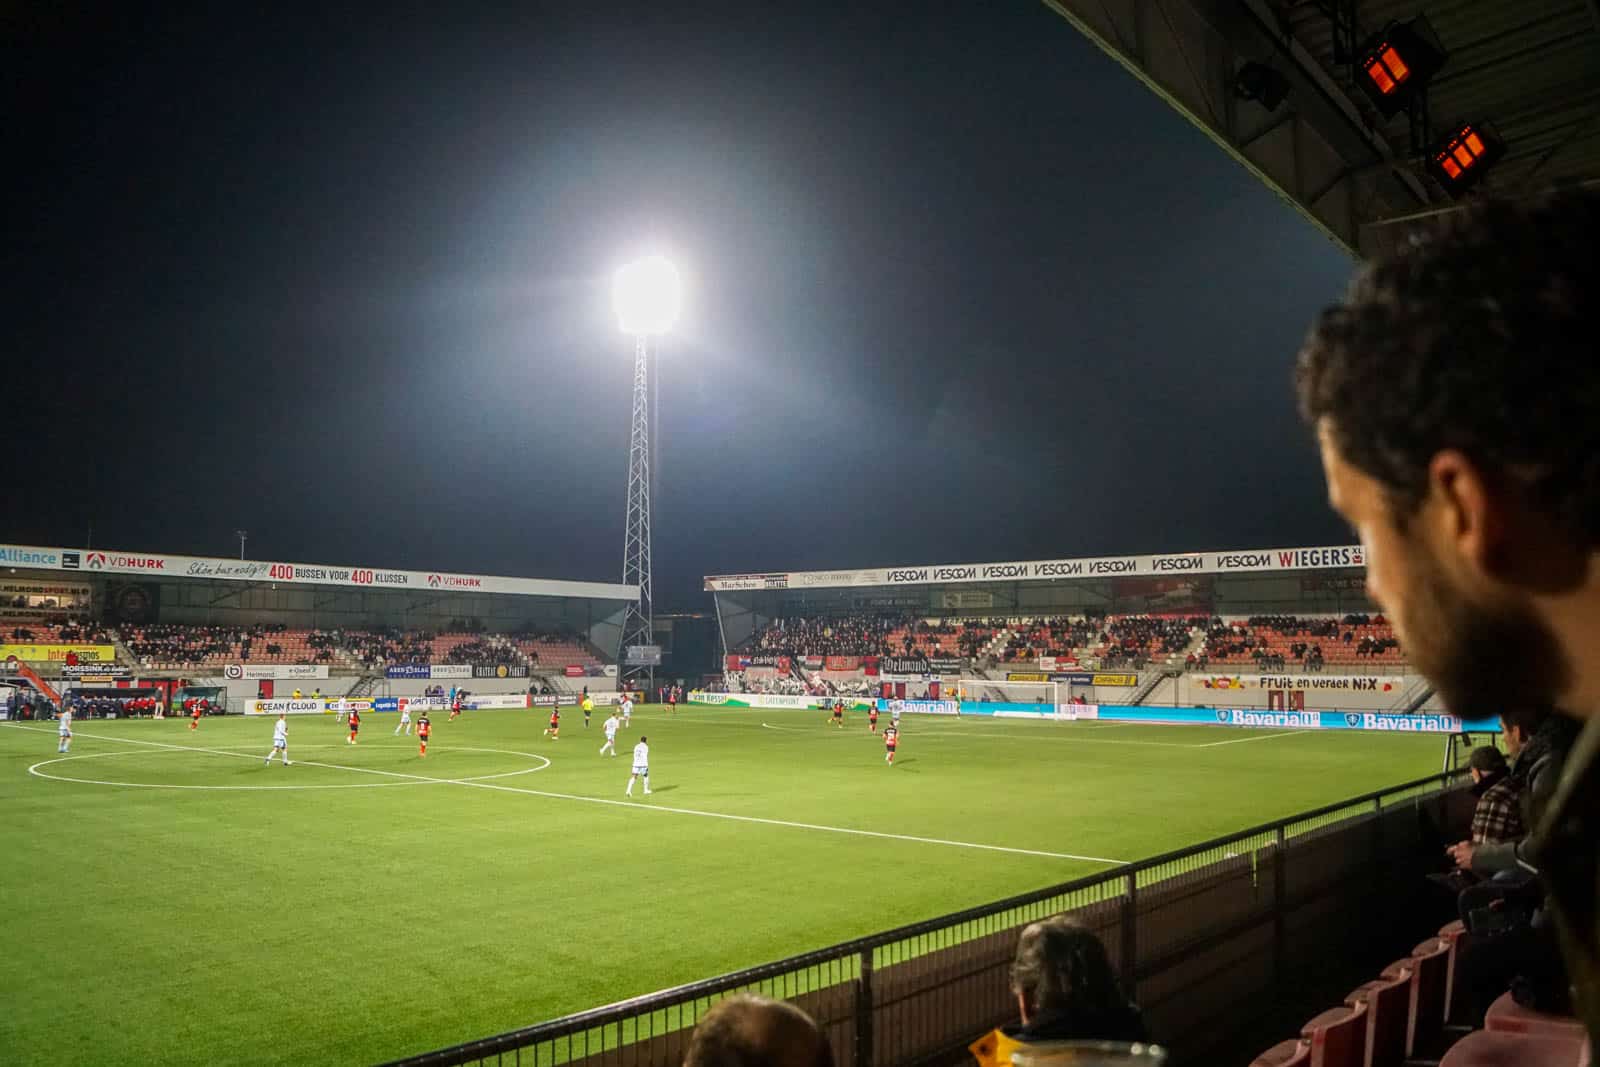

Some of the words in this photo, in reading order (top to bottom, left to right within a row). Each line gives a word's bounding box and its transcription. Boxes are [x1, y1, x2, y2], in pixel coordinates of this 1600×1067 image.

[0, 549, 57, 564] Alliance
[110, 556, 165, 569] VDHURK
[1278, 548, 1350, 567] WIEGERS
[269, 564, 293, 580] 400
[295, 568, 326, 580] BUSSEN
[329, 570, 349, 581] VOOR
[351, 570, 373, 584] 400
[375, 573, 408, 584] KLUSSEN
[887, 570, 928, 582] VESCOM
[933, 567, 976, 580] VESCOM
[982, 565, 1028, 578] VESCOM
[1034, 562, 1082, 576] VESCOM
[1089, 559, 1136, 573] VESCOM
[1152, 557, 1203, 571] VESCOM
[1217, 554, 1271, 568] VESCOM
[443, 576, 481, 587] VDHURK
[1259, 676, 1293, 689] Fruit
[1296, 678, 1310, 688] en
[255, 701, 285, 711] OCEAN
[291, 702, 317, 711] CLOUD
[899, 701, 945, 713] avaria
[1232, 709, 1300, 726] Bavaria
[1363, 713, 1439, 731] Bavaria
